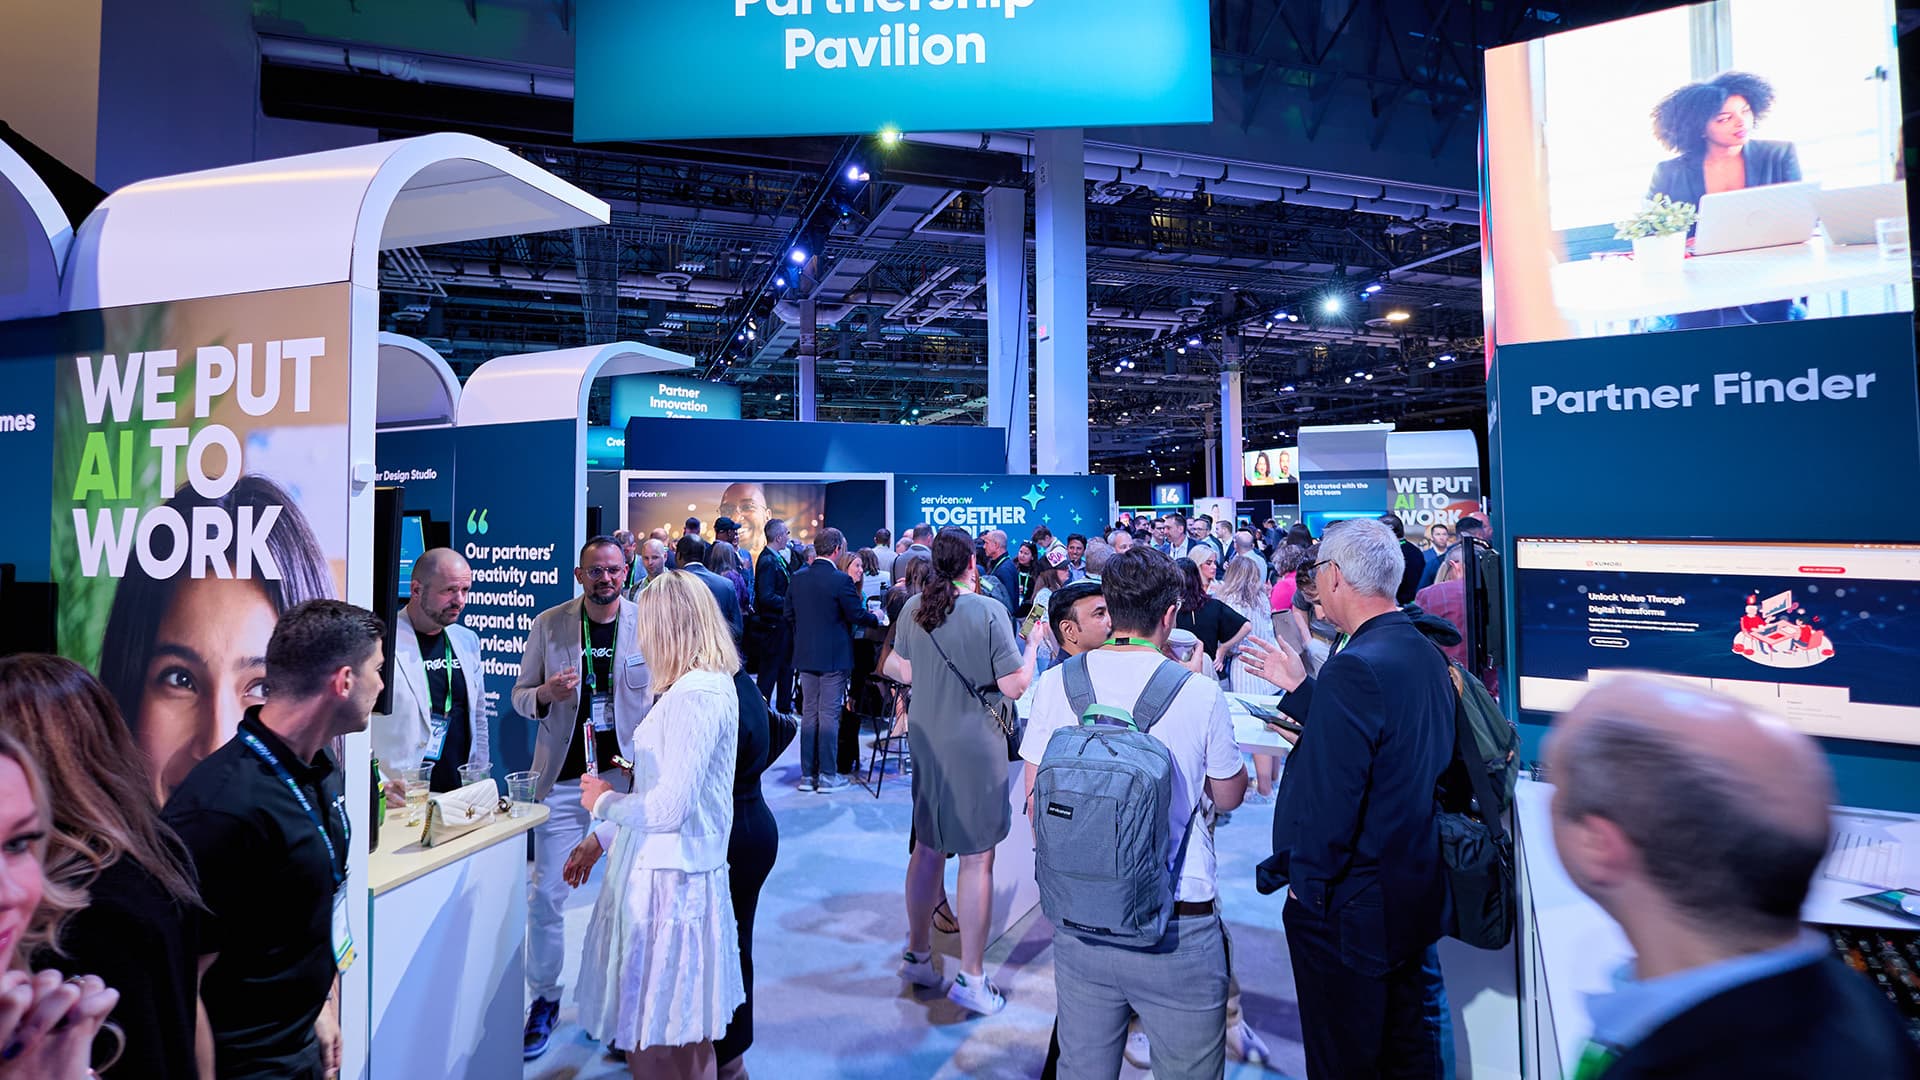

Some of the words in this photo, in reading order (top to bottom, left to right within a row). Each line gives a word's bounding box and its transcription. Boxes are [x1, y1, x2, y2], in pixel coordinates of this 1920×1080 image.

[785, 23, 986, 69] Pavilion
[76, 349, 178, 424] WE
[194, 337, 326, 418] PUT
[658, 383, 701, 399] Partner
[1531, 383, 1700, 415] Partner
[1713, 368, 1876, 405] Finder
[649, 396, 708, 412] Innovation
[72, 430, 134, 500] AI
[150, 424, 242, 499] TO
[383, 469, 410, 483] Design
[410, 468, 437, 480] Studio
[1392, 477, 1428, 493] WE
[1432, 476, 1473, 493] PUT
[920, 495, 973, 505] servicenow
[1394, 494, 1416, 509] AI
[1418, 493, 1450, 509] TO
[921, 506, 1026, 525] TOGETHER
[1394, 509, 1463, 526] WORK
[72, 505, 283, 580] WORK
[465, 542, 490, 559] Our
[472, 565, 528, 588] reativity
[530, 567, 559, 585] and
[1588, 592, 1619, 602] Unlock
[1620, 593, 1646, 603] Value
[1646, 594, 1686, 605] Through
[1588, 605, 1616, 614] Digital
[464, 612, 514, 631] expand
